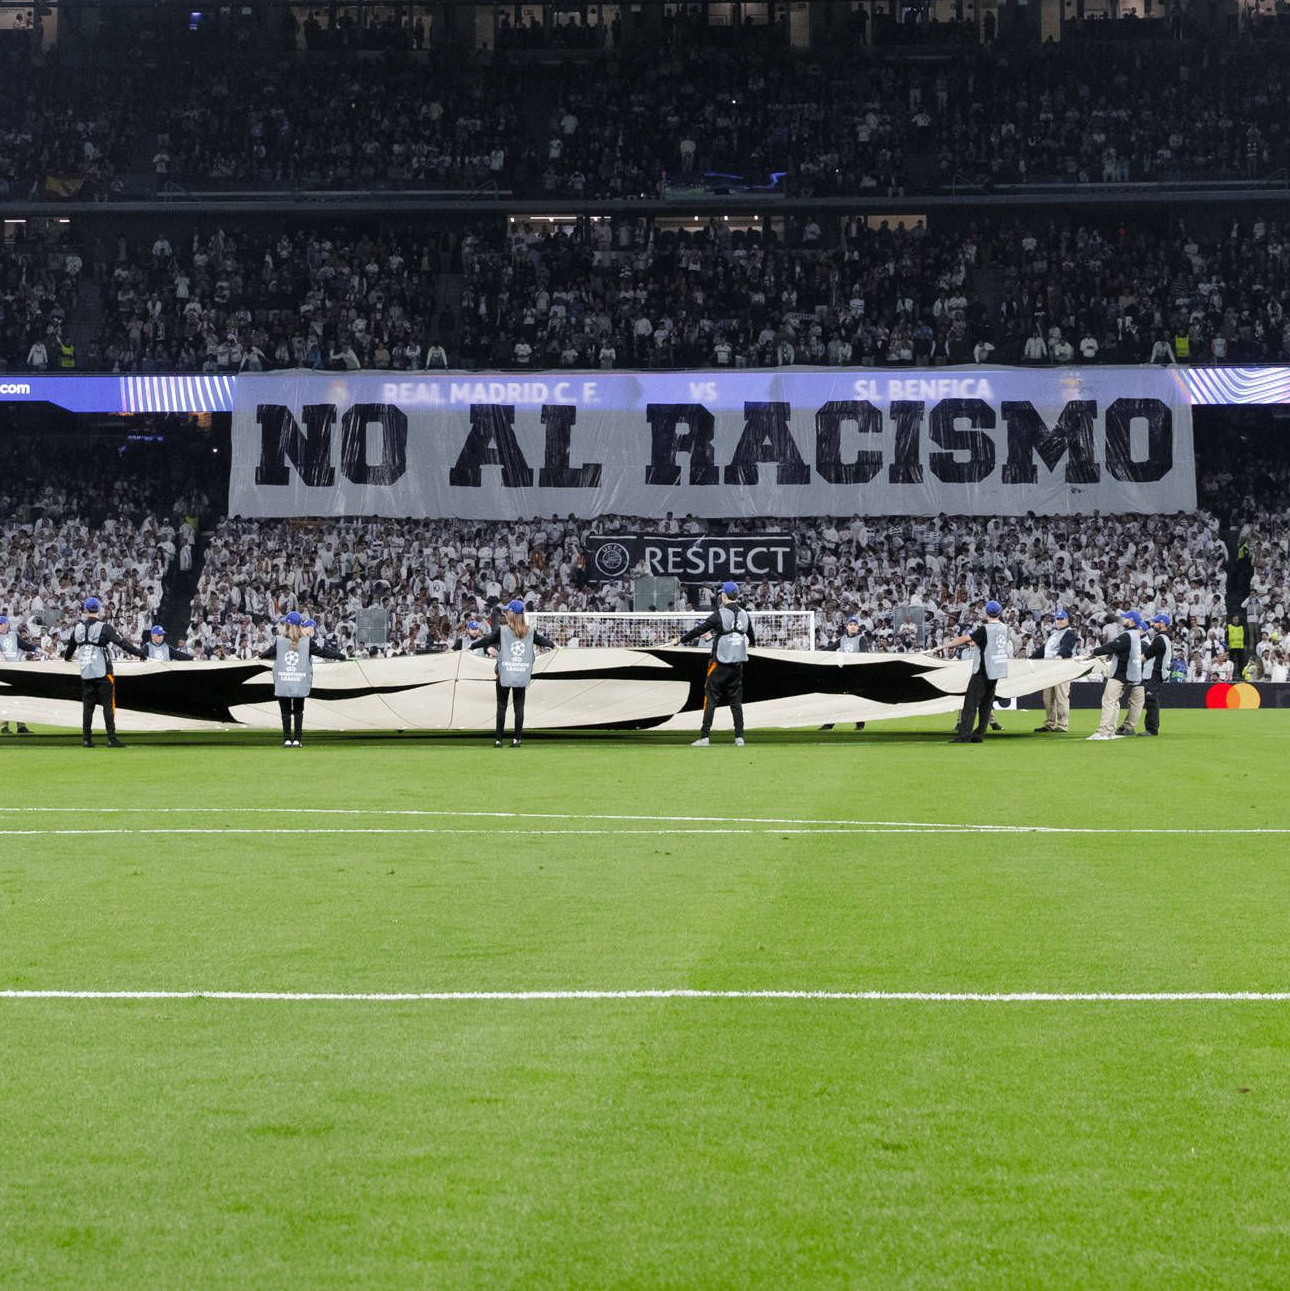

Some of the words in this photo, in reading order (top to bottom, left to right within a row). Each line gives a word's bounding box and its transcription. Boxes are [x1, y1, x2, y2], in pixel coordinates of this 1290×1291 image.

[382, 382, 447, 404] REAL
[449, 382, 549, 404] MADRID
[688, 382, 718, 403] VS
[853, 379, 883, 400] SL
[888, 378, 995, 400] BENFICA
[254, 401, 408, 489] NO
[449, 401, 602, 489] AL
[644, 397, 1175, 488] RACISMO
[644, 546, 791, 574] RESPECT
